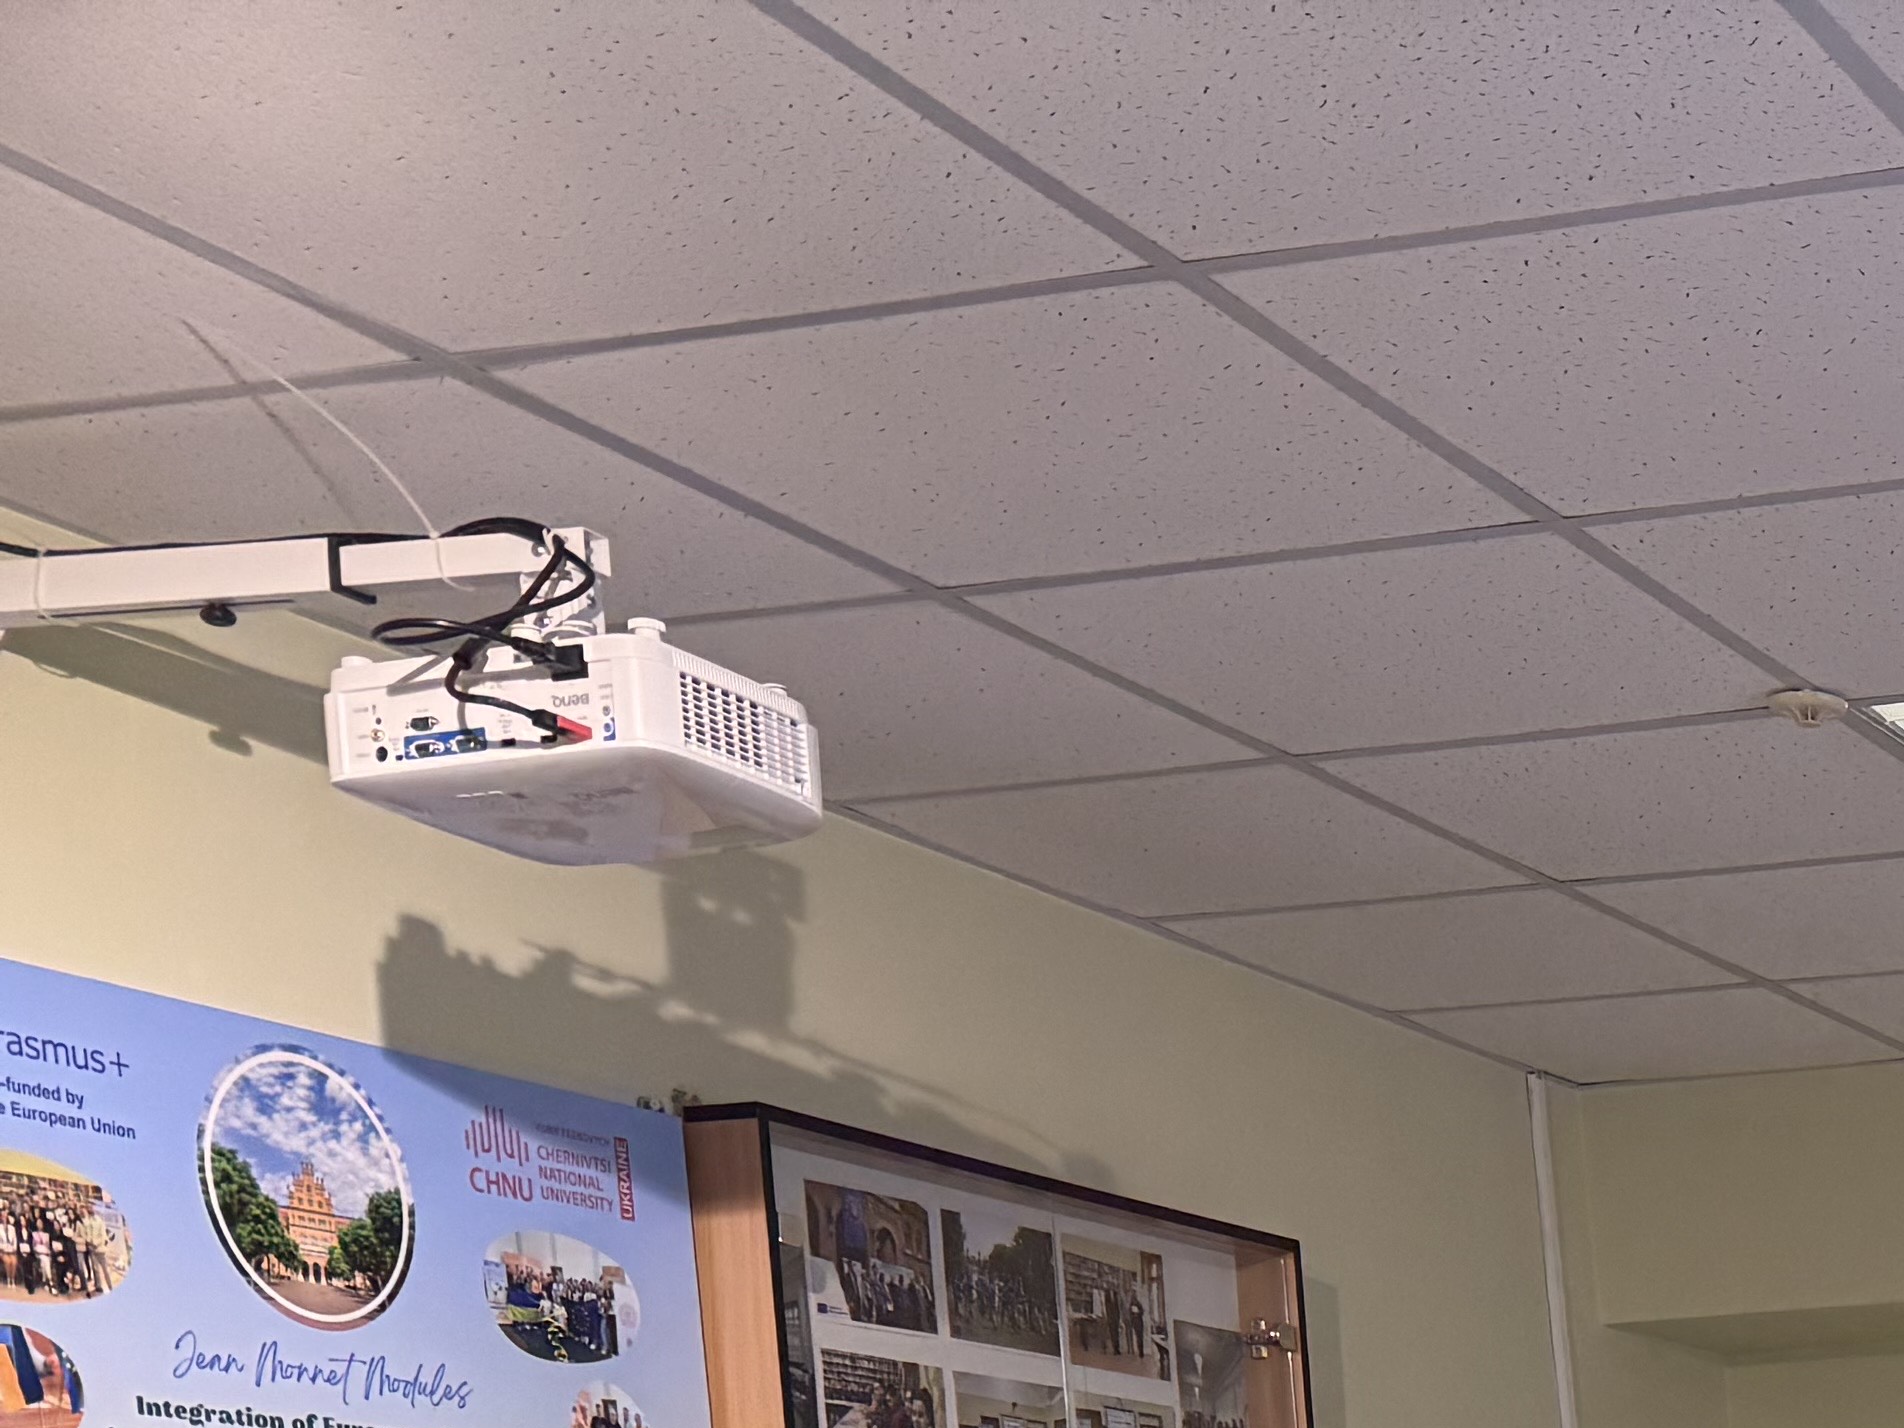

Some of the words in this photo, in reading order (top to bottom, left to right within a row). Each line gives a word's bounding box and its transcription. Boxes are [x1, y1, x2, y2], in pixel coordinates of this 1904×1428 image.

[65, 1088, 85, 1110] by
[10, 1100, 87, 1129] European
[90, 1116, 137, 1140] Union
[537, 1144, 613, 1174] CHERNIVTSI
[469, 1166, 534, 1203] CHNU
[538, 1165, 604, 1193] NATIONAL
[615, 1137, 633, 1219] UKRAINE
[540, 1185, 614, 1213] UNIVERSITY
[172, 1329, 245, 1379] Jean
[254, 1340, 367, 1406] Monnet
[364, 1354, 474, 1410] Modules
